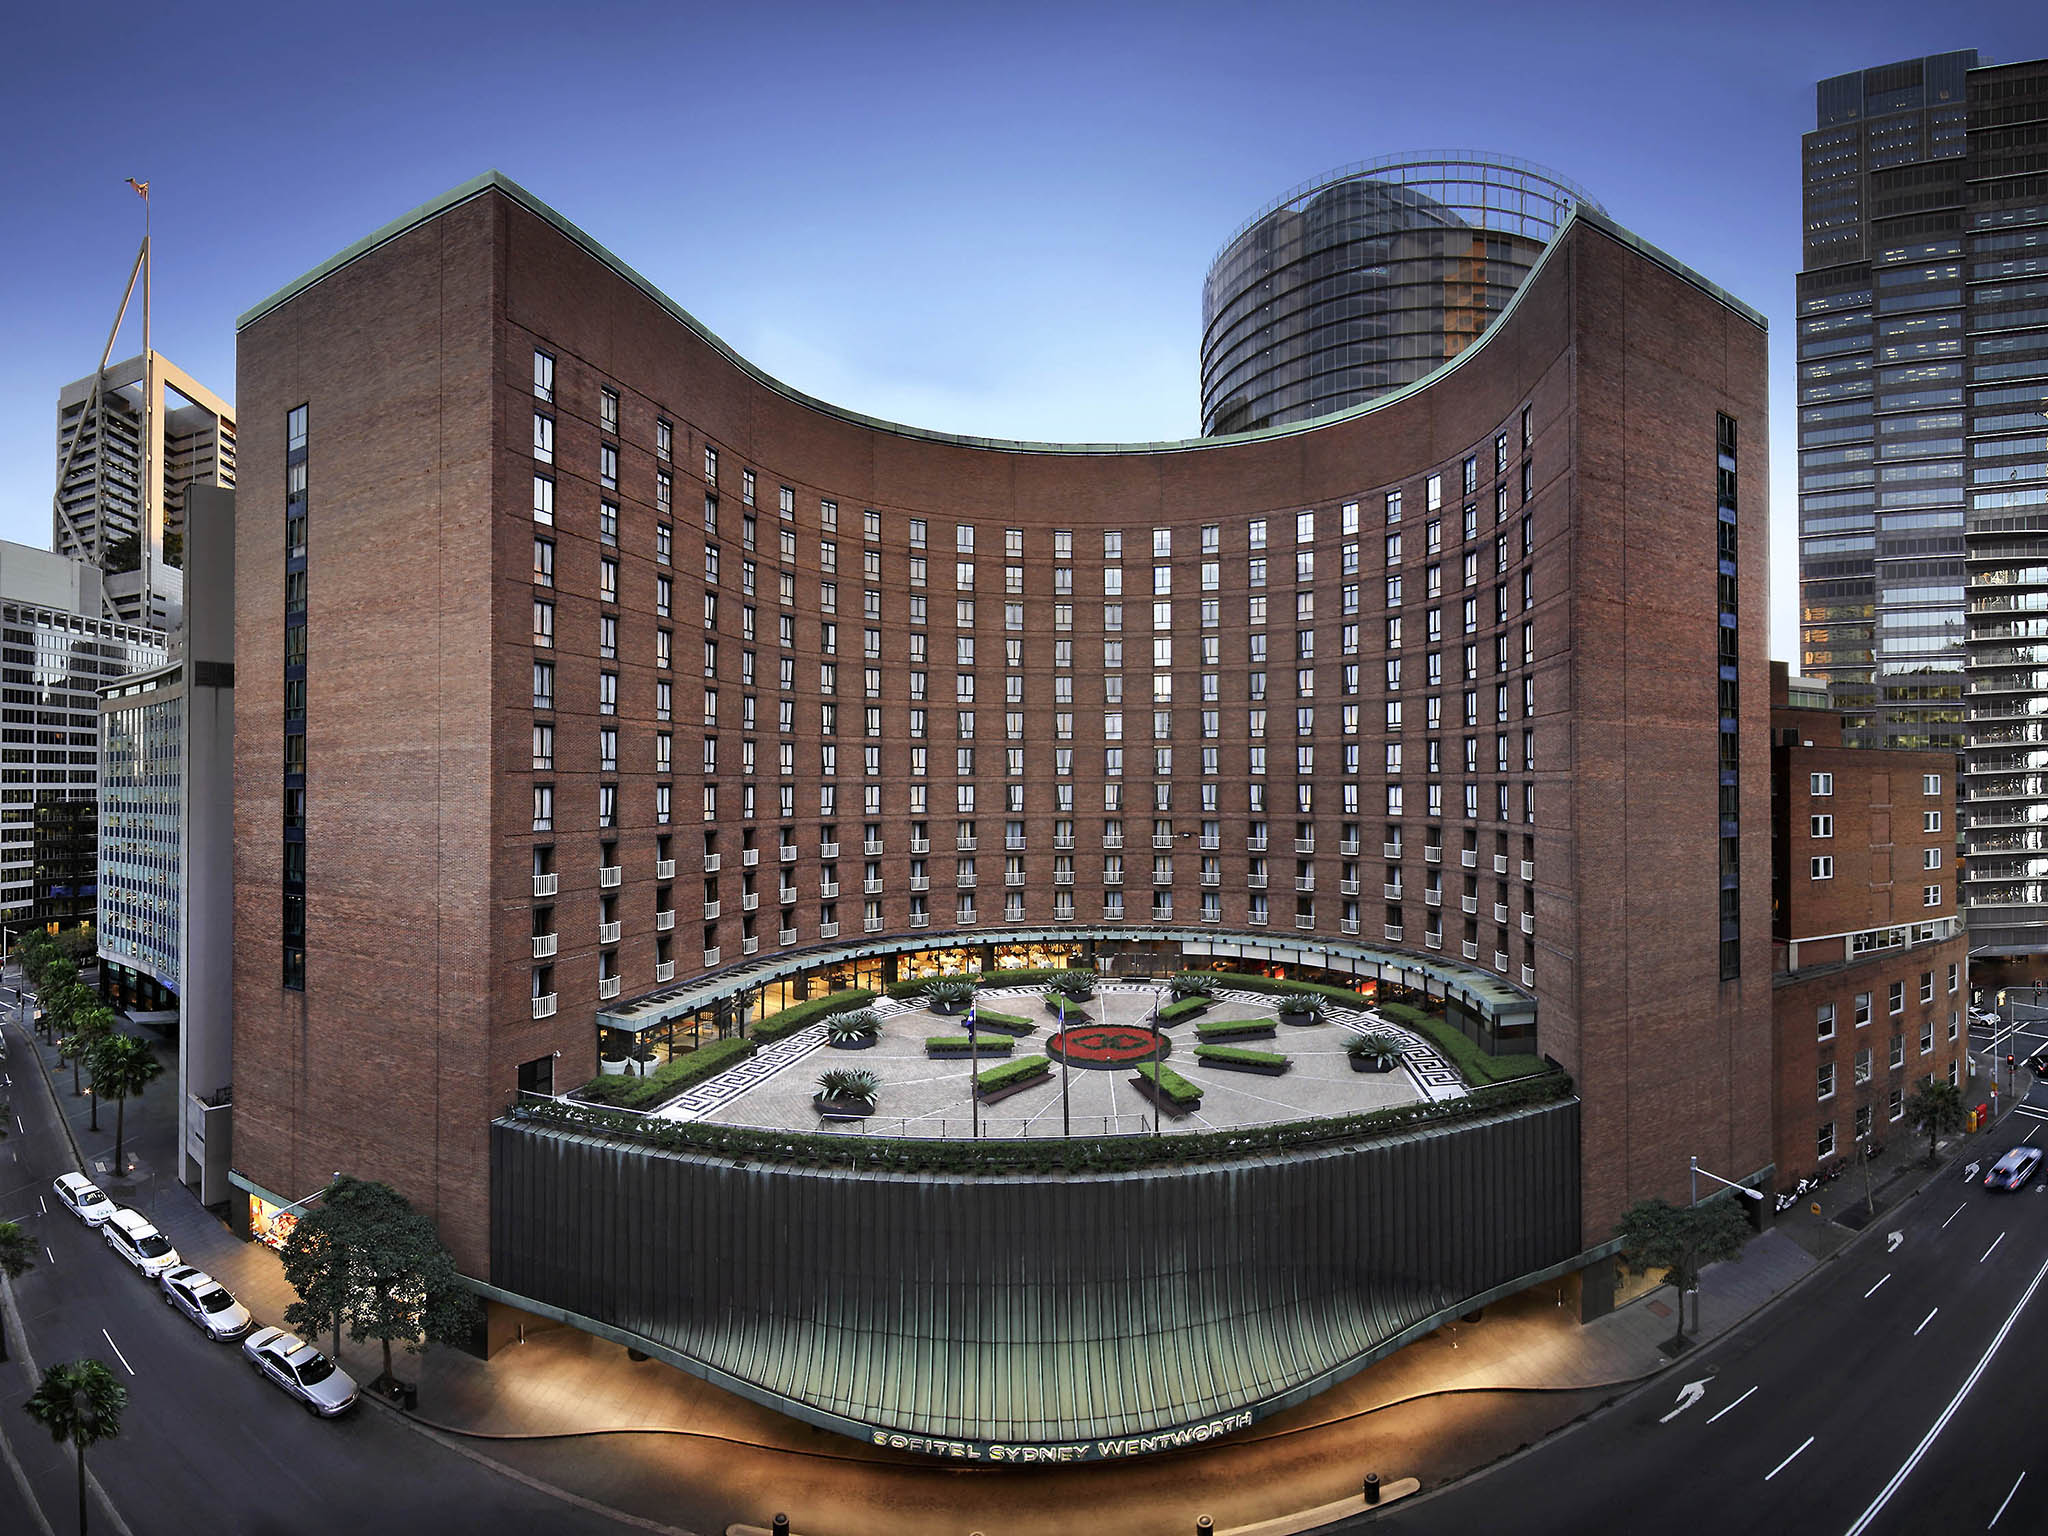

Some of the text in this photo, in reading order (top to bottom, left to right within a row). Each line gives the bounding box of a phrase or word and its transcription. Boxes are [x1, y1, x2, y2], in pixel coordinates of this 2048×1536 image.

[872, 1411, 1252, 1462] SOFITEL SYDNEY WENTWORTH
